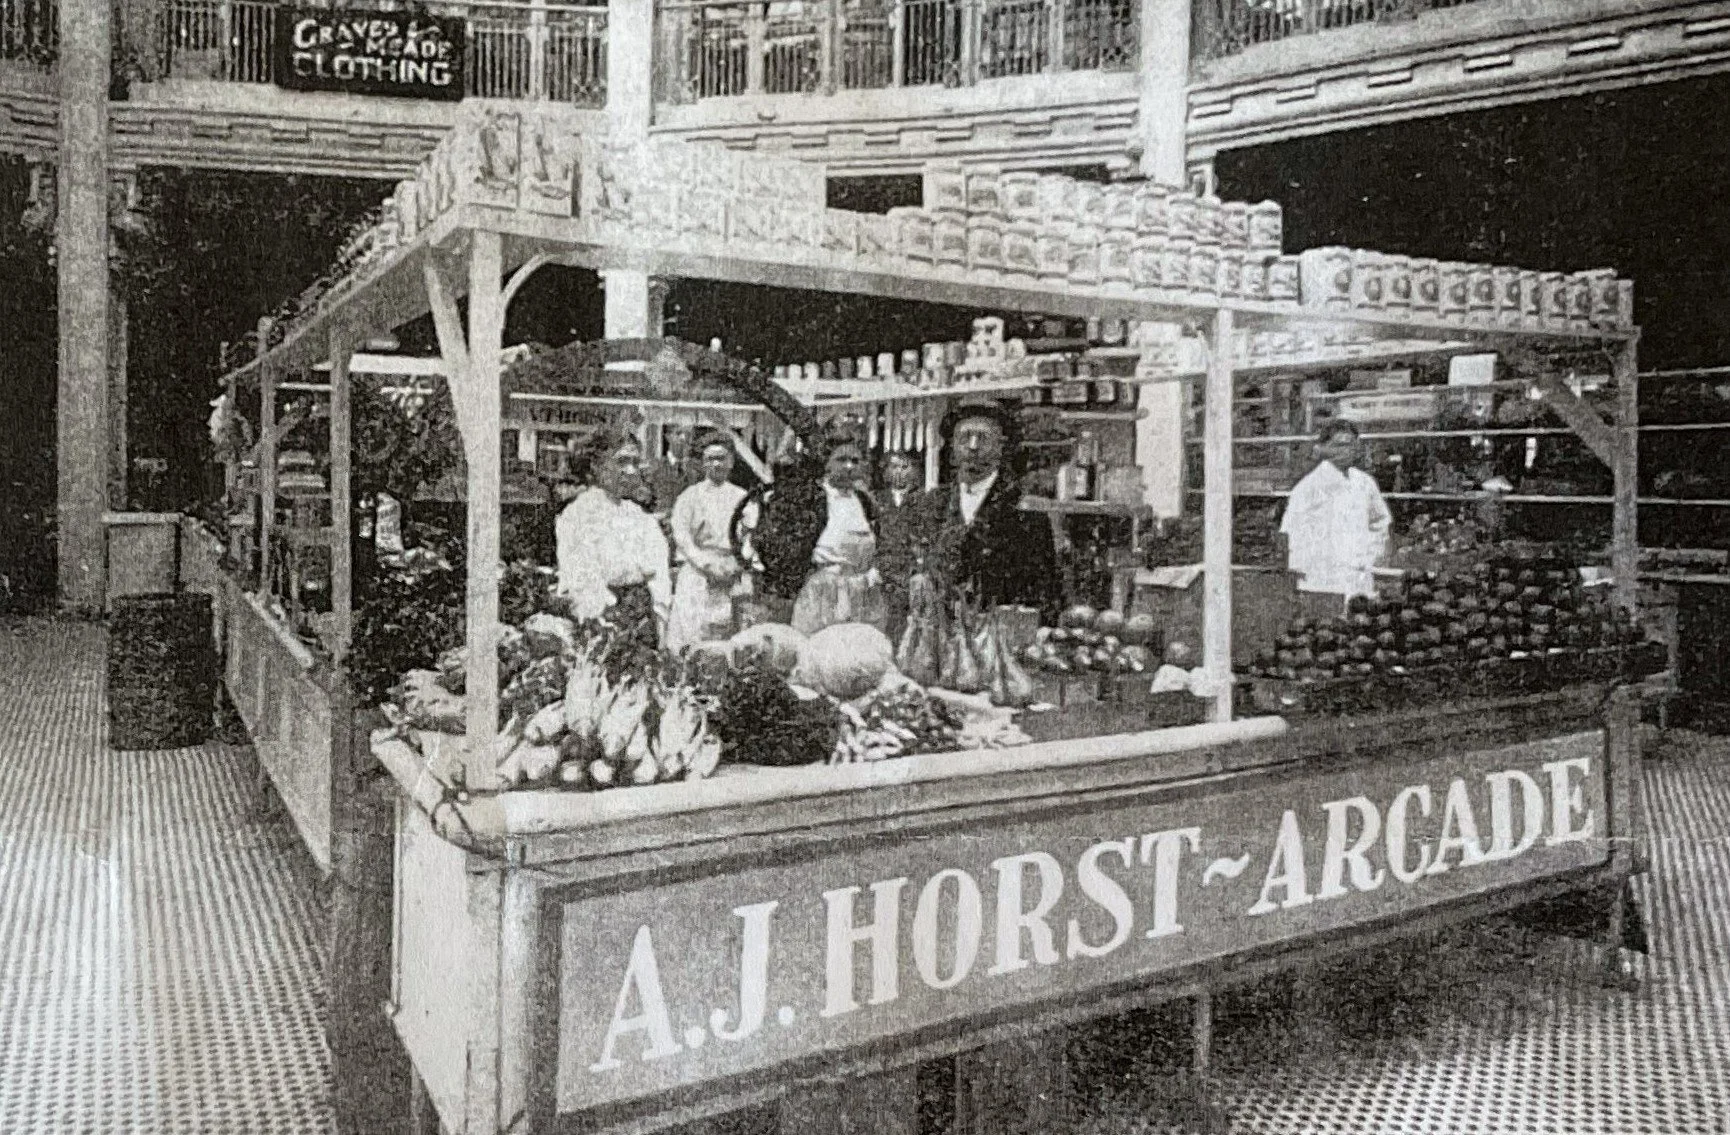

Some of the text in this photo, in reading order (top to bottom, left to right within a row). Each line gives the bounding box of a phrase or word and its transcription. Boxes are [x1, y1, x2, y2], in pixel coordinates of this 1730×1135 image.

[293, 18, 399, 49] GRAVES
[292, 51, 452, 86] CLOTHING
[1248, 757, 1596, 917] ARCADE
